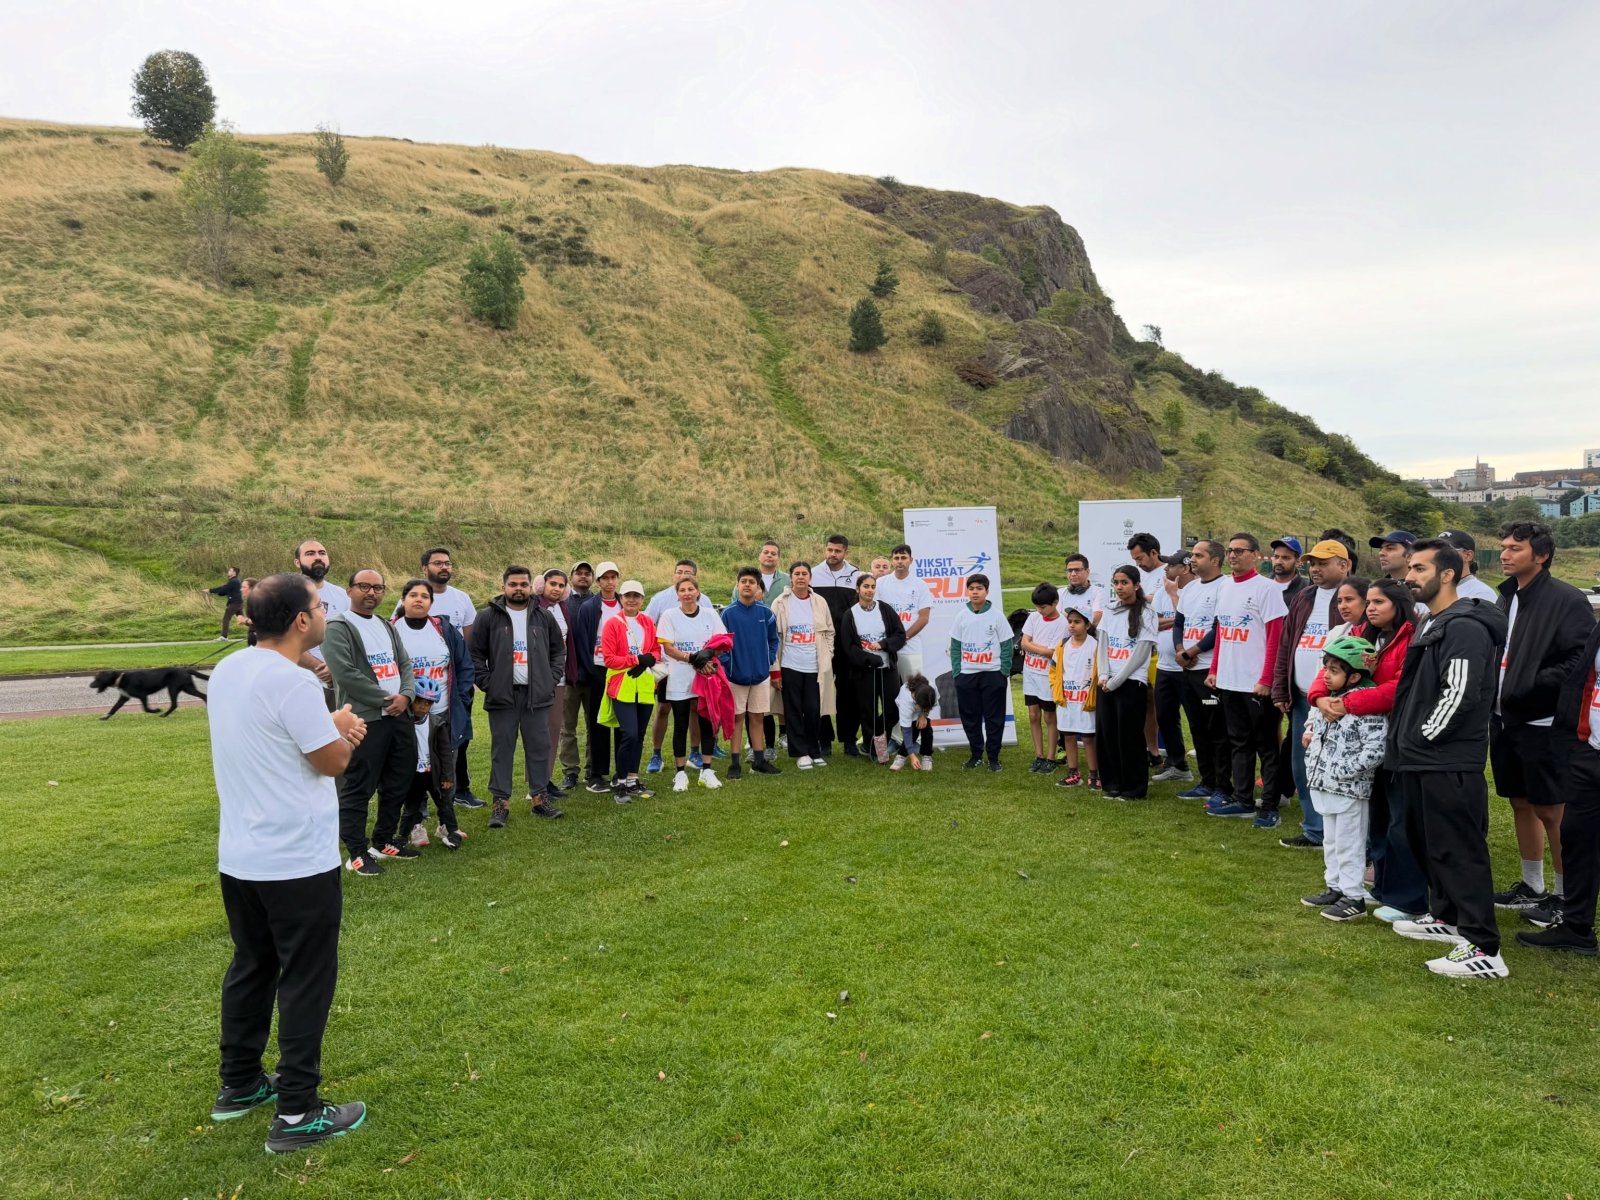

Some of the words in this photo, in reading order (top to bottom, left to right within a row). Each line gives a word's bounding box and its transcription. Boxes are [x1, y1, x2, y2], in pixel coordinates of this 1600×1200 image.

[915, 558, 953, 568] VIKSIT
[916, 567, 964, 577] BHARAT
[1184, 627, 1206, 641] UN
[1300, 635, 1327, 649] RU
[963, 652, 992, 663] RUN
